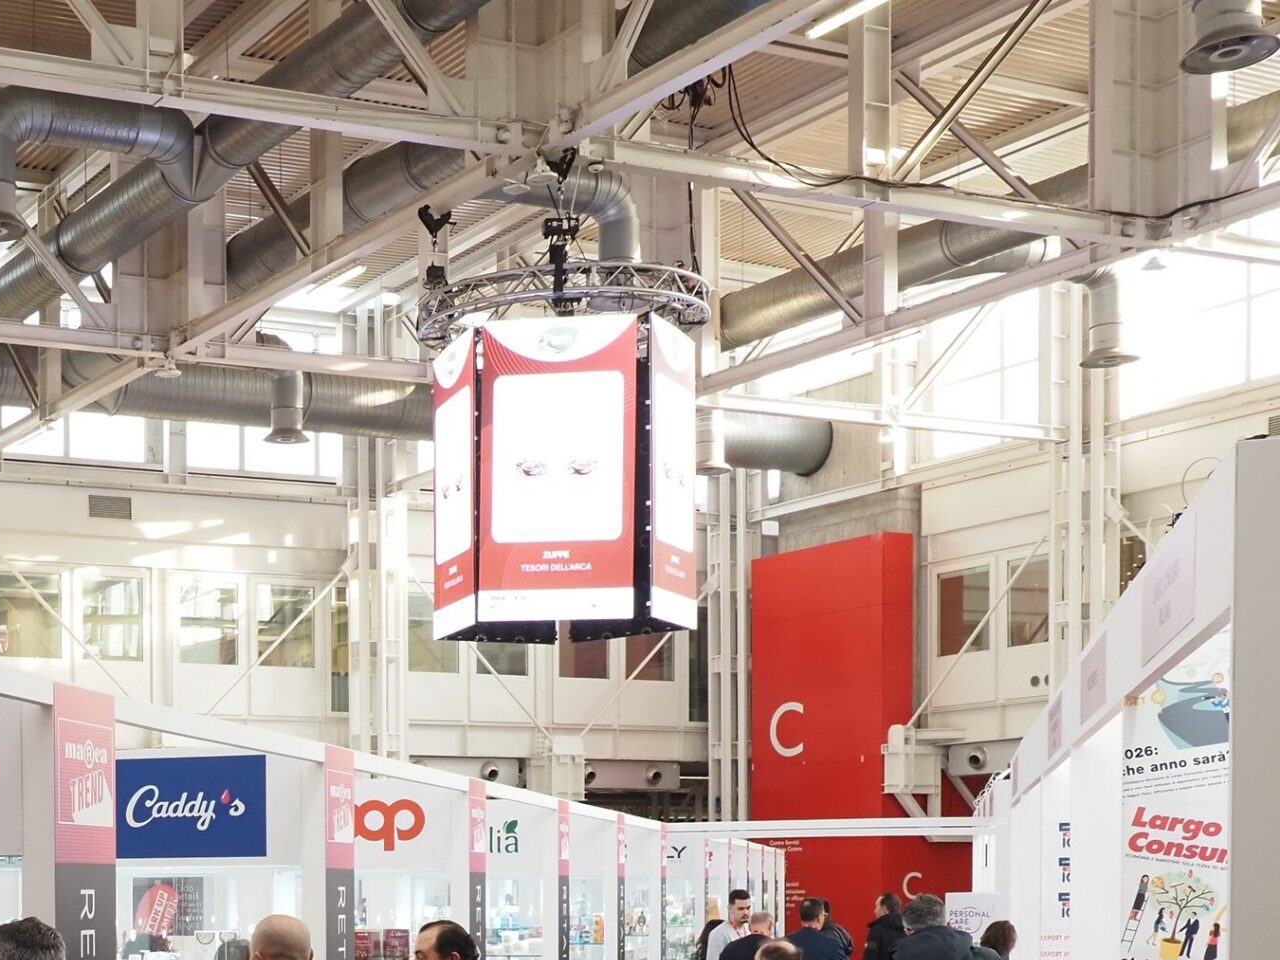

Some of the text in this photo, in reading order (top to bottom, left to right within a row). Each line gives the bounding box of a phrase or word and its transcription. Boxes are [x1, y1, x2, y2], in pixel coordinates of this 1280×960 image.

[521, 564, 549, 572] TESORI
[770, 702, 804, 758] C
[1123, 746, 1158, 760] 026:
[1151, 759, 1187, 772] anno
[70, 769, 105, 816] TREND
[126, 785, 246, 831] Caddy's
[1131, 806, 1222, 840] Largo
[489, 826, 519, 853] lia
